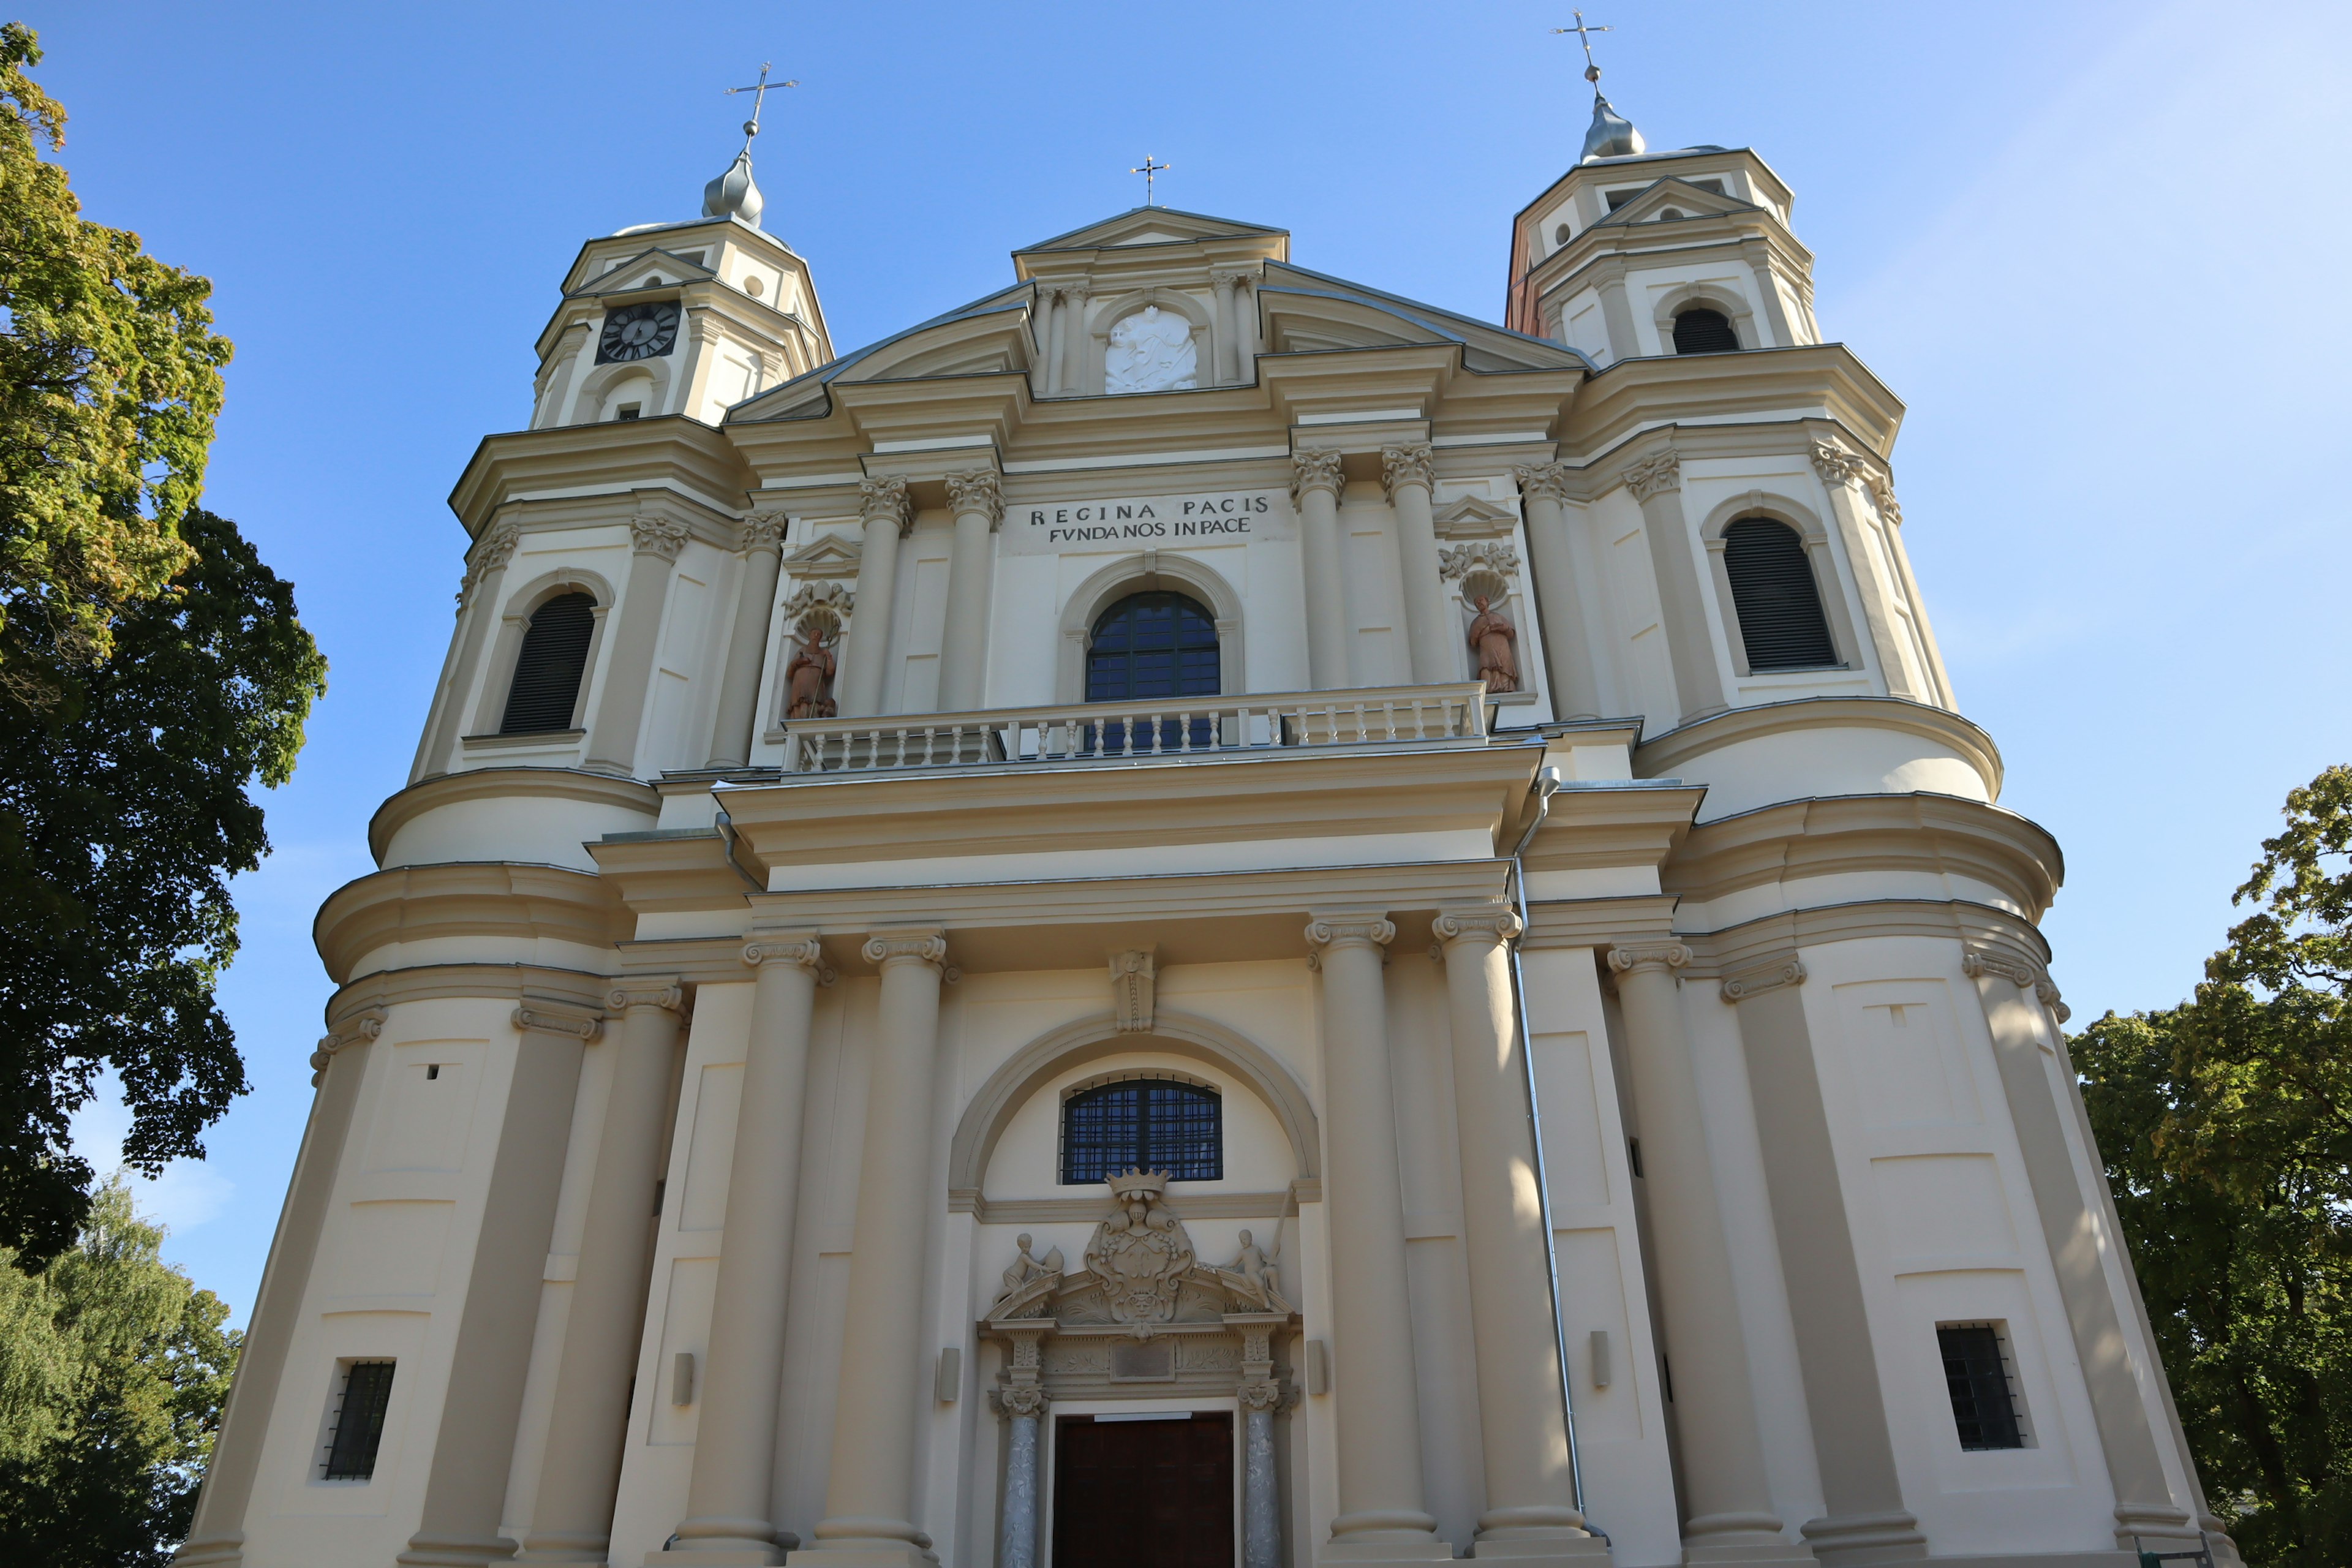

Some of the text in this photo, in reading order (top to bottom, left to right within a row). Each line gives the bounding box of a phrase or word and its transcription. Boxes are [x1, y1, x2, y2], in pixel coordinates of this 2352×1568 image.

[1031, 497, 1268, 526] REGINA PACIS
[1123, 522, 1166, 538] NOS
